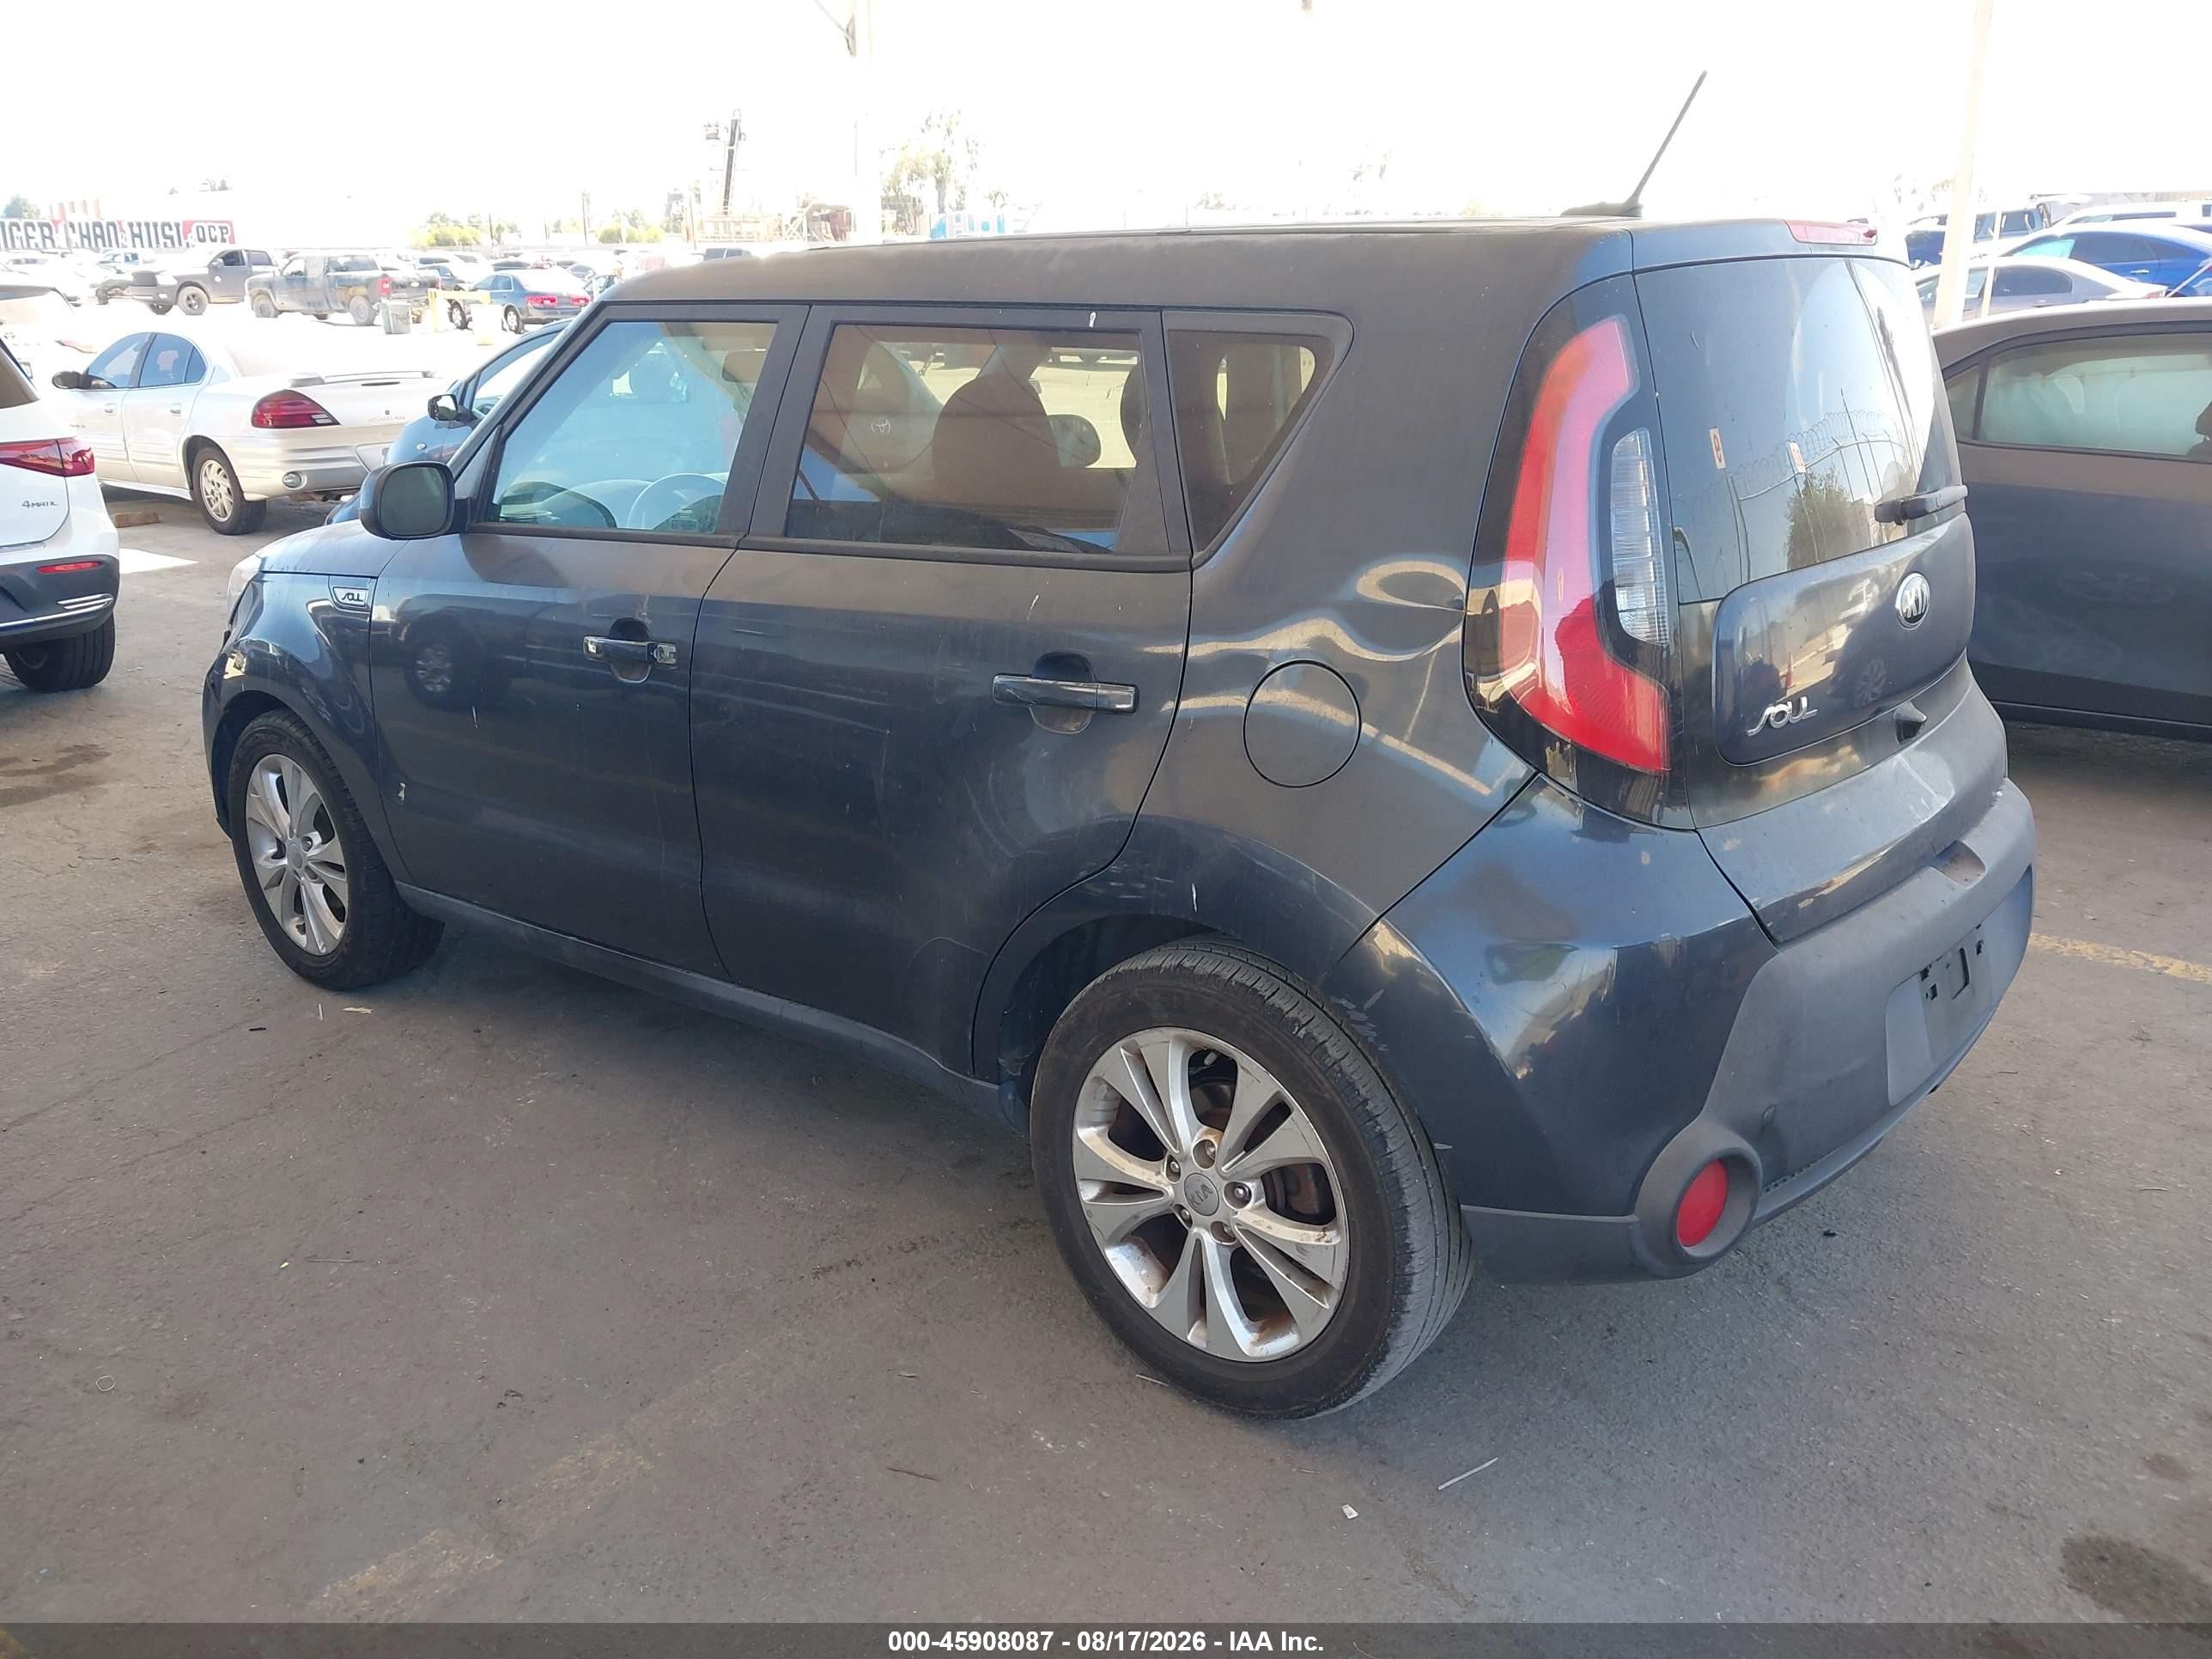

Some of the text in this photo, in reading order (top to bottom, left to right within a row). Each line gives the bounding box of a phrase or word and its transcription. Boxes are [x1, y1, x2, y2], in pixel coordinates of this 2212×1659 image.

[195, 224, 229, 243] OCP
[1746, 696, 1820, 737] SOUL
[1188, 1182, 1214, 1209] KIA
